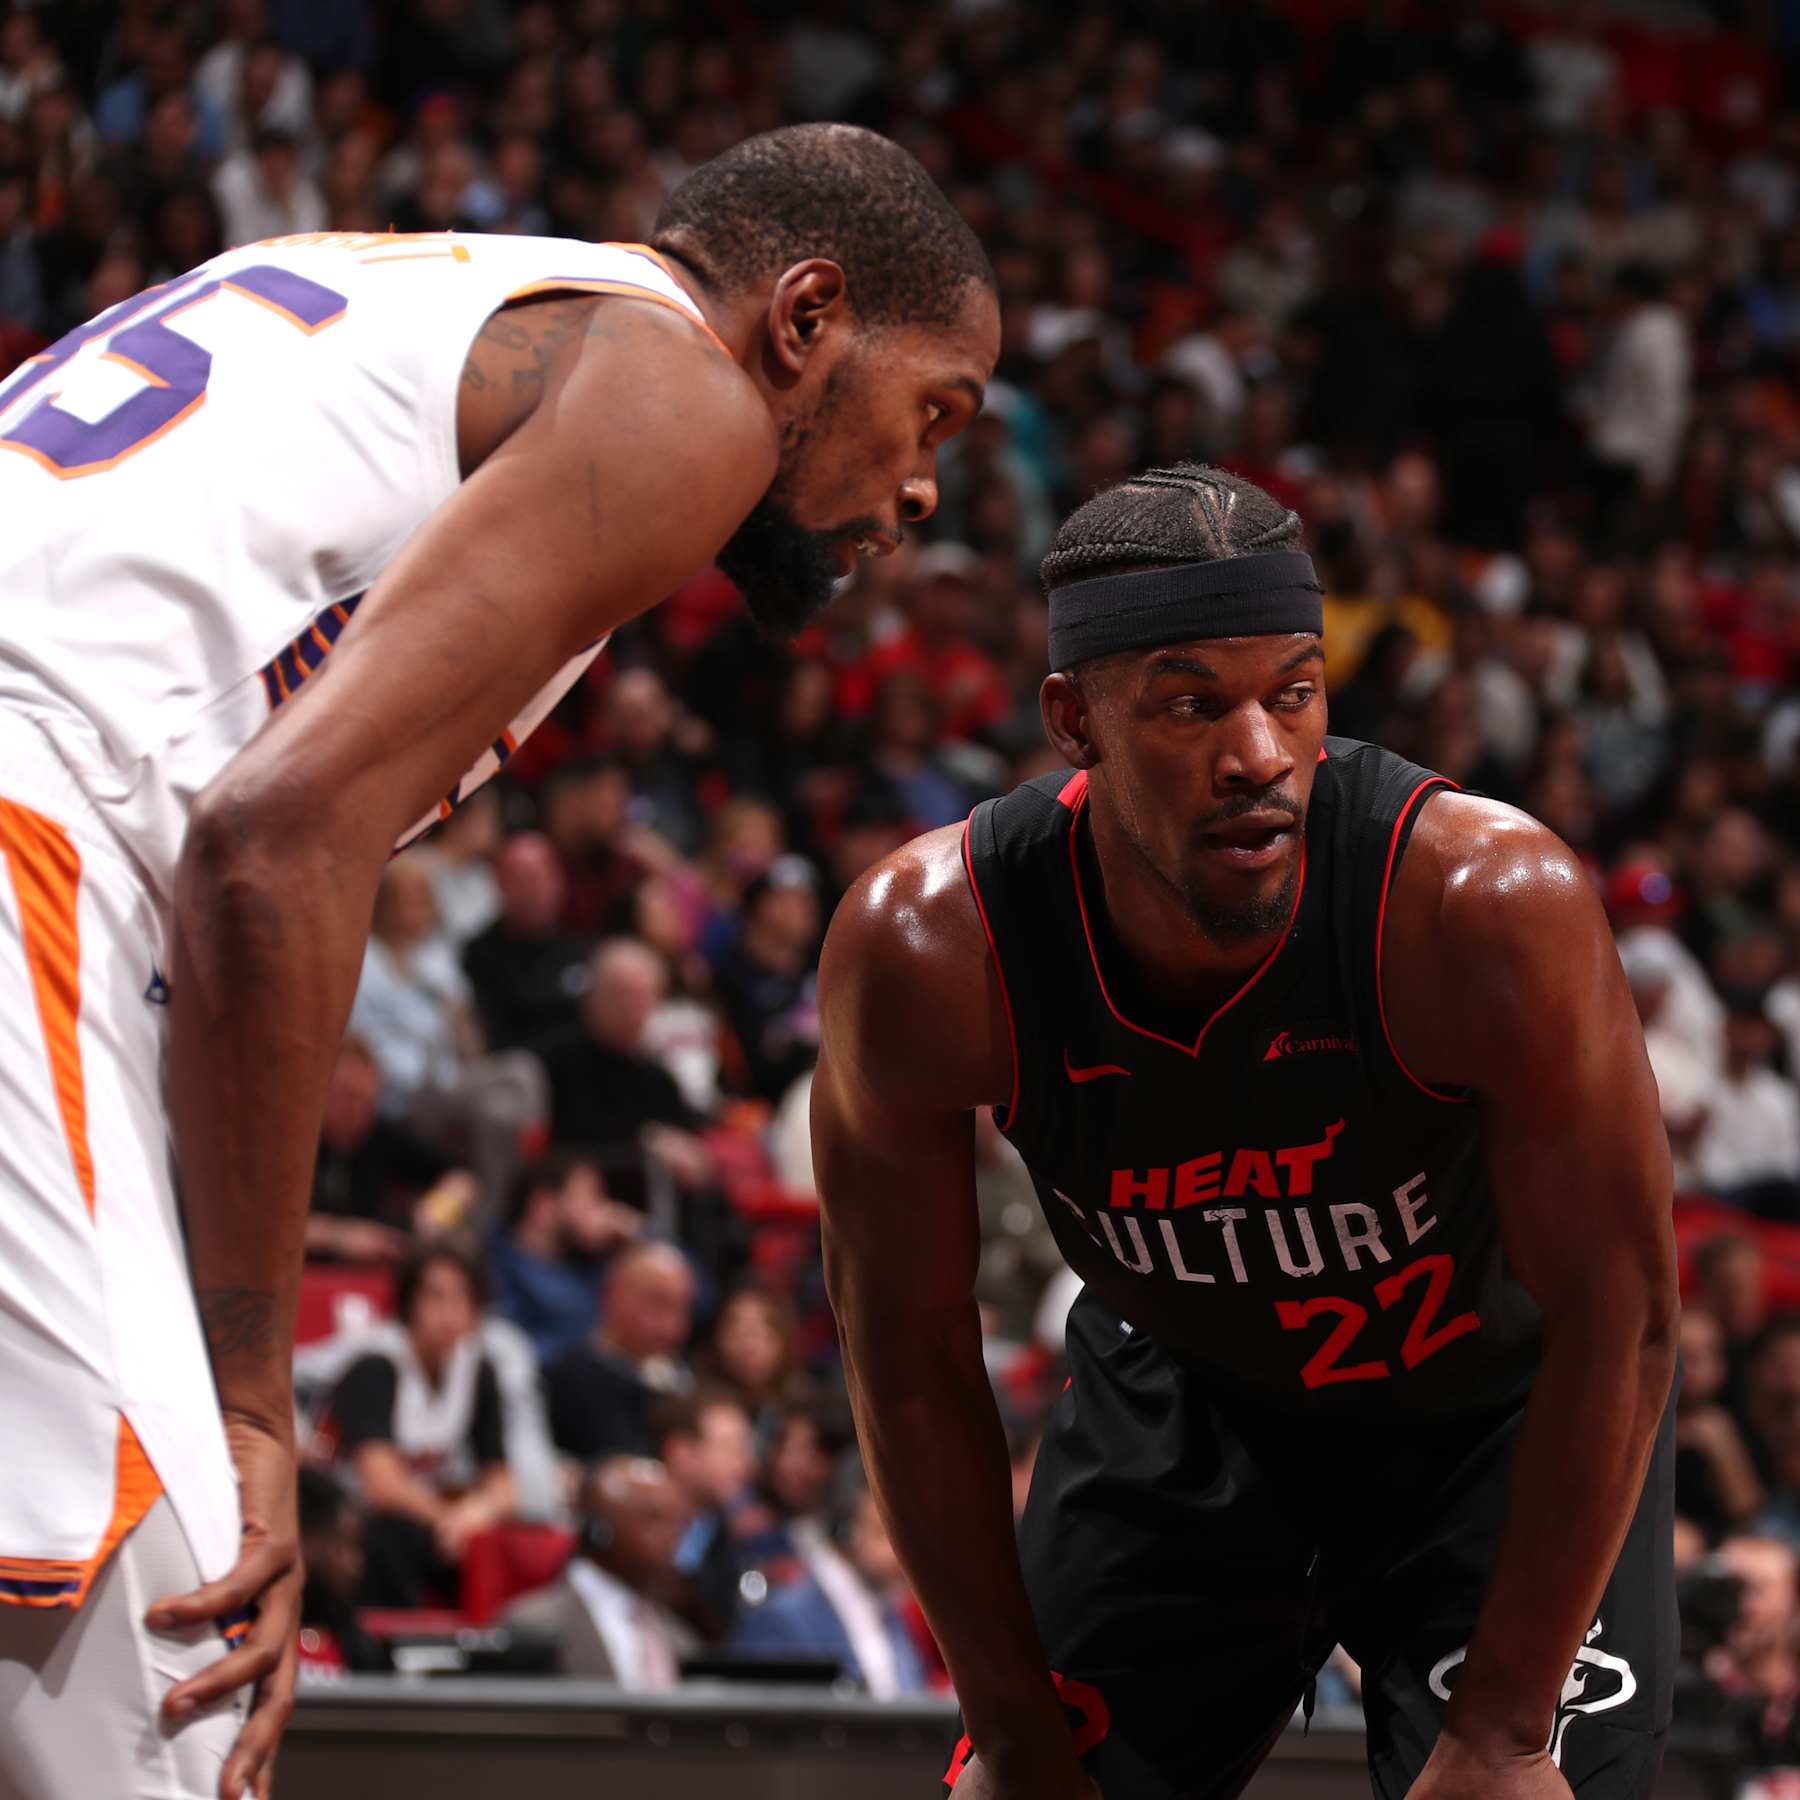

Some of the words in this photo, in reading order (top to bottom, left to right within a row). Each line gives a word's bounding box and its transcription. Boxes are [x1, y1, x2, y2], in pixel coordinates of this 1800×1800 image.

[1285, 1033, 1357, 1056] Carniva
[1109, 1119, 1346, 1211] HEAT
[1274, 1255, 1481, 1390] 22
